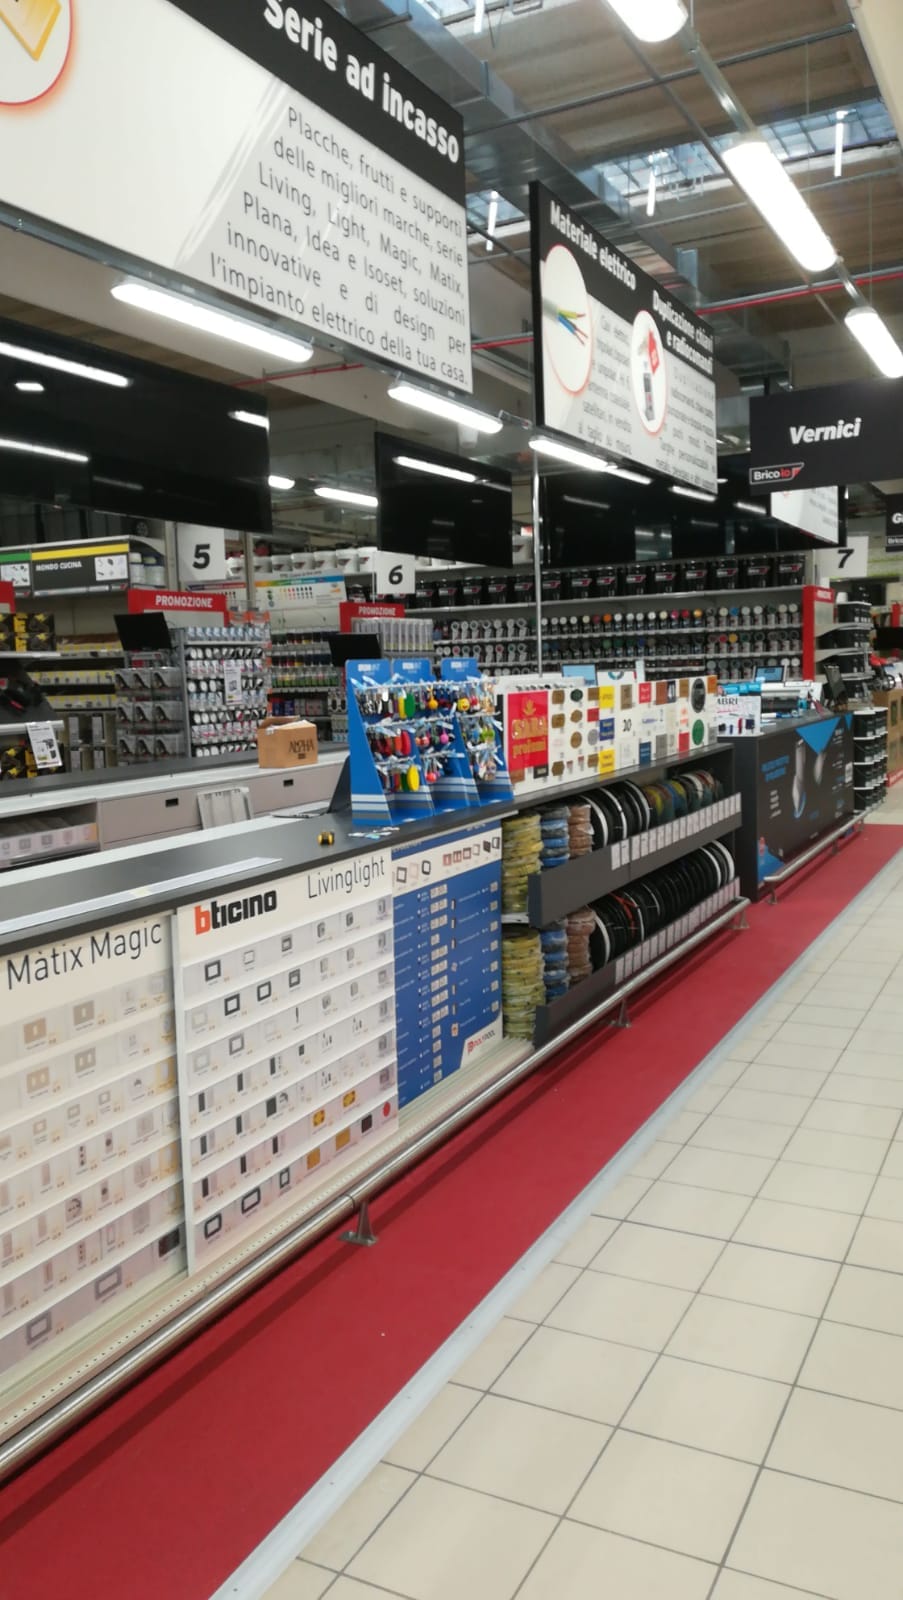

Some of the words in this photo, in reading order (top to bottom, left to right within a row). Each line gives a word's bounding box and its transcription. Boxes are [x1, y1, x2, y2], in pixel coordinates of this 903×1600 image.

[263, 0, 338, 71] Serie
[346, 54, 375, 101] ad
[382, 72, 460, 164] incasso
[288, 106, 353, 170] Placche,
[359, 154, 395, 194] frutti
[400, 186, 407, 202] e
[413, 192, 462, 237] supporti
[274, 137, 315, 178] delle
[321, 167, 378, 216] migliori
[383, 205, 433, 249] marche,
[436, 239, 463, 268] serie
[259, 162, 316, 217] Living,
[328, 201, 370, 247] Light,
[380, 232, 422, 272] Magic,
[430, 262, 464, 299] Matix,
[551, 200, 597, 260] Materiale
[600, 247, 636, 290] elettrico
[243, 192, 298, 242] Plana,
[306, 225, 340, 262] Idea
[348, 252, 356, 270] e
[364, 260, 407, 298] Isoset,
[413, 286, 465, 326] soluzioni
[227, 222, 321, 287] innovative
[339, 282, 348, 299] e
[365, 293, 378, 314] di
[394, 303, 435, 341] design
[449, 334, 466, 355] per
[653, 289, 695, 339] Duplicazione
[312, 303, 375, 345] elettrico
[380, 330, 412, 361] della
[417, 345, 436, 371] tua
[441, 360, 469, 385] casa.
[666, 330, 672, 346] e
[789, 417, 862, 444] Vernici
[892, 512, 903, 524] G
[60, 561, 82, 570] CUCINA
[192, 543, 211, 569] 5
[389, 565, 403, 585] 6
[837, 549, 854, 569] 7
[155, 595, 213, 608] PROMOZIONE
[358, 606, 396, 616] PROMOZIONE
[307, 855, 386, 900] Livinglight
[194, 889, 278, 935] bticino
[6, 943, 84, 991] Màtix
[90, 921, 163, 964] Magic
